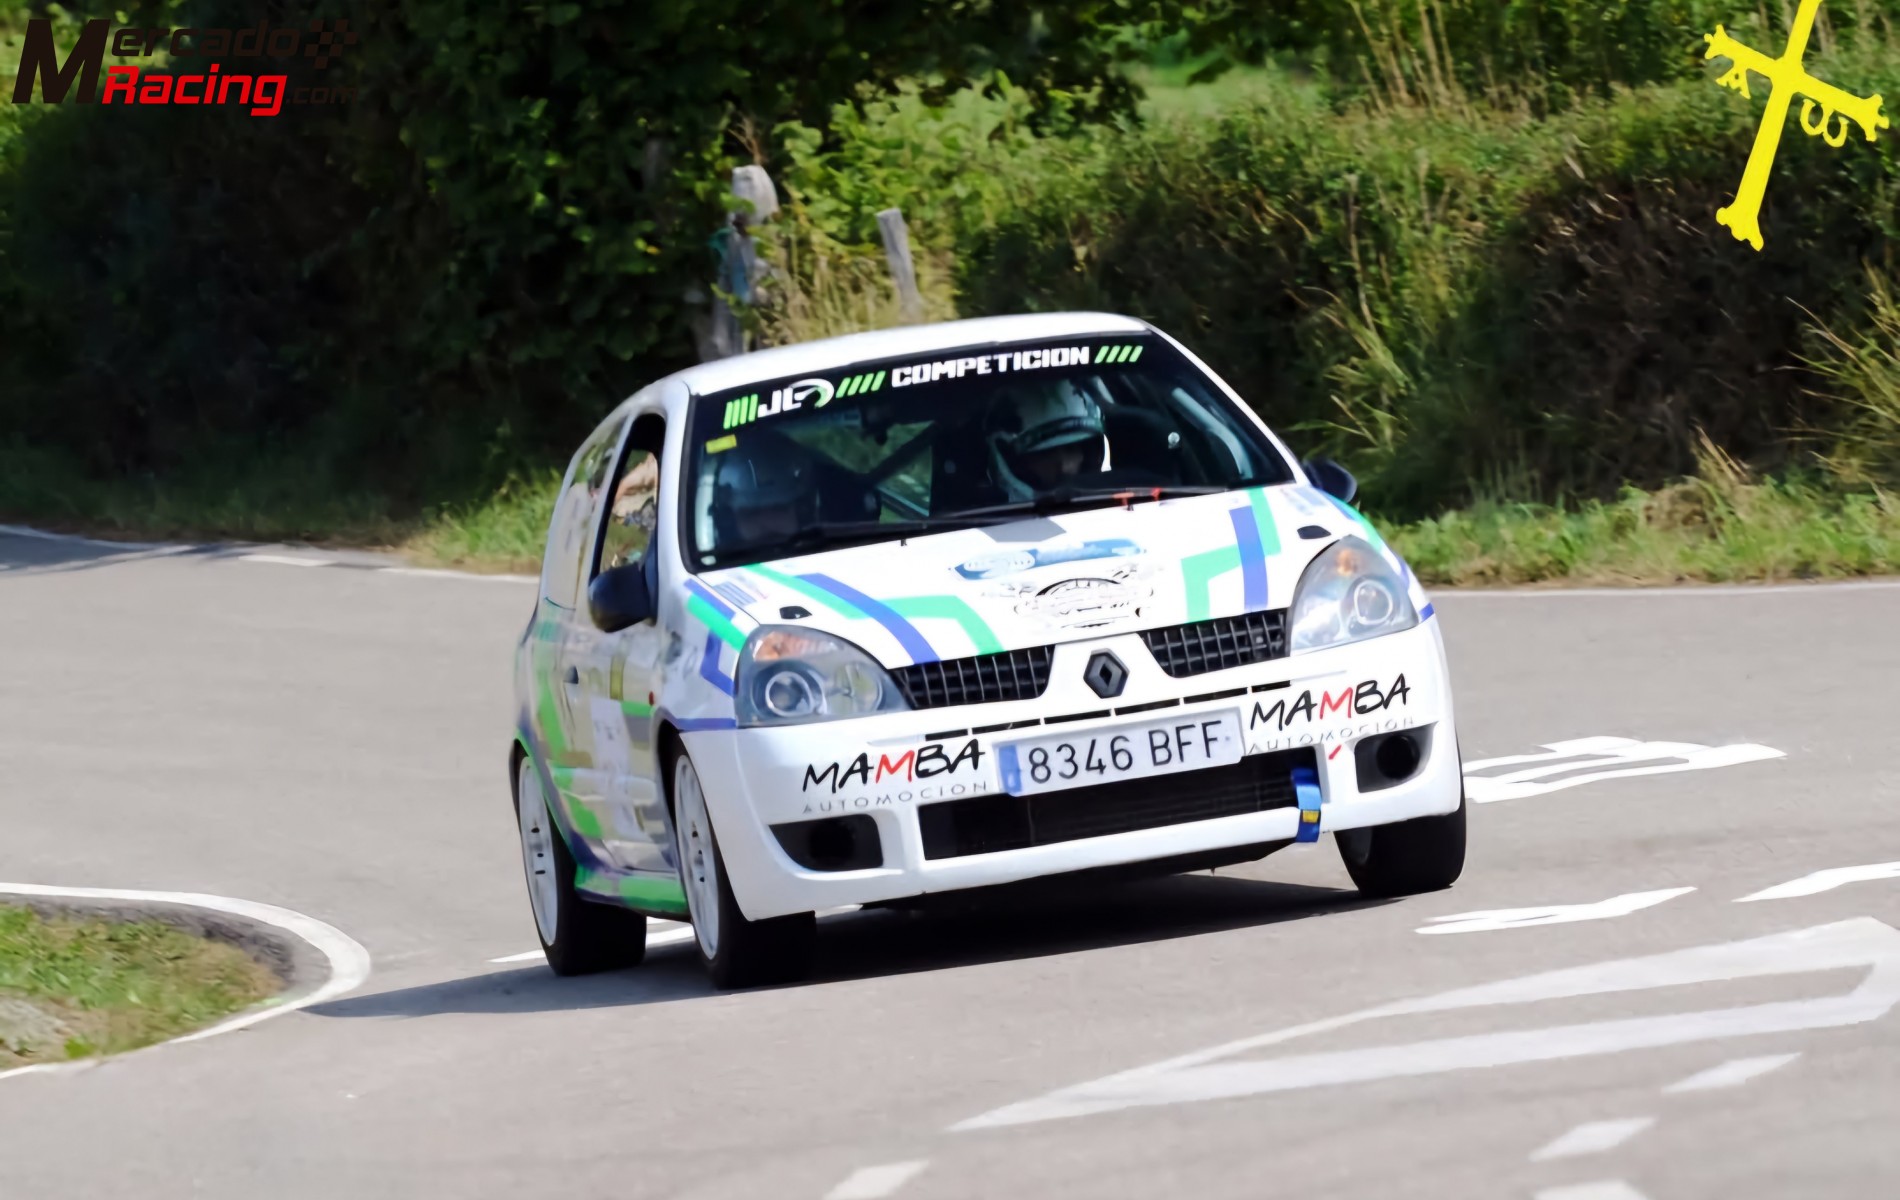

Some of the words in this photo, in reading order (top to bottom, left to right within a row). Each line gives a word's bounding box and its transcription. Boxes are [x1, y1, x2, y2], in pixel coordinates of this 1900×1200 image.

[891, 345, 1090, 389] COMPETICION
[1249, 672, 1411, 732] MAMBA
[802, 738, 986, 794] MAMBA
[1028, 735, 1133, 784] 8346
[1148, 720, 1222, 767] BFF
[802, 780, 988, 814] AUTOMOCION
